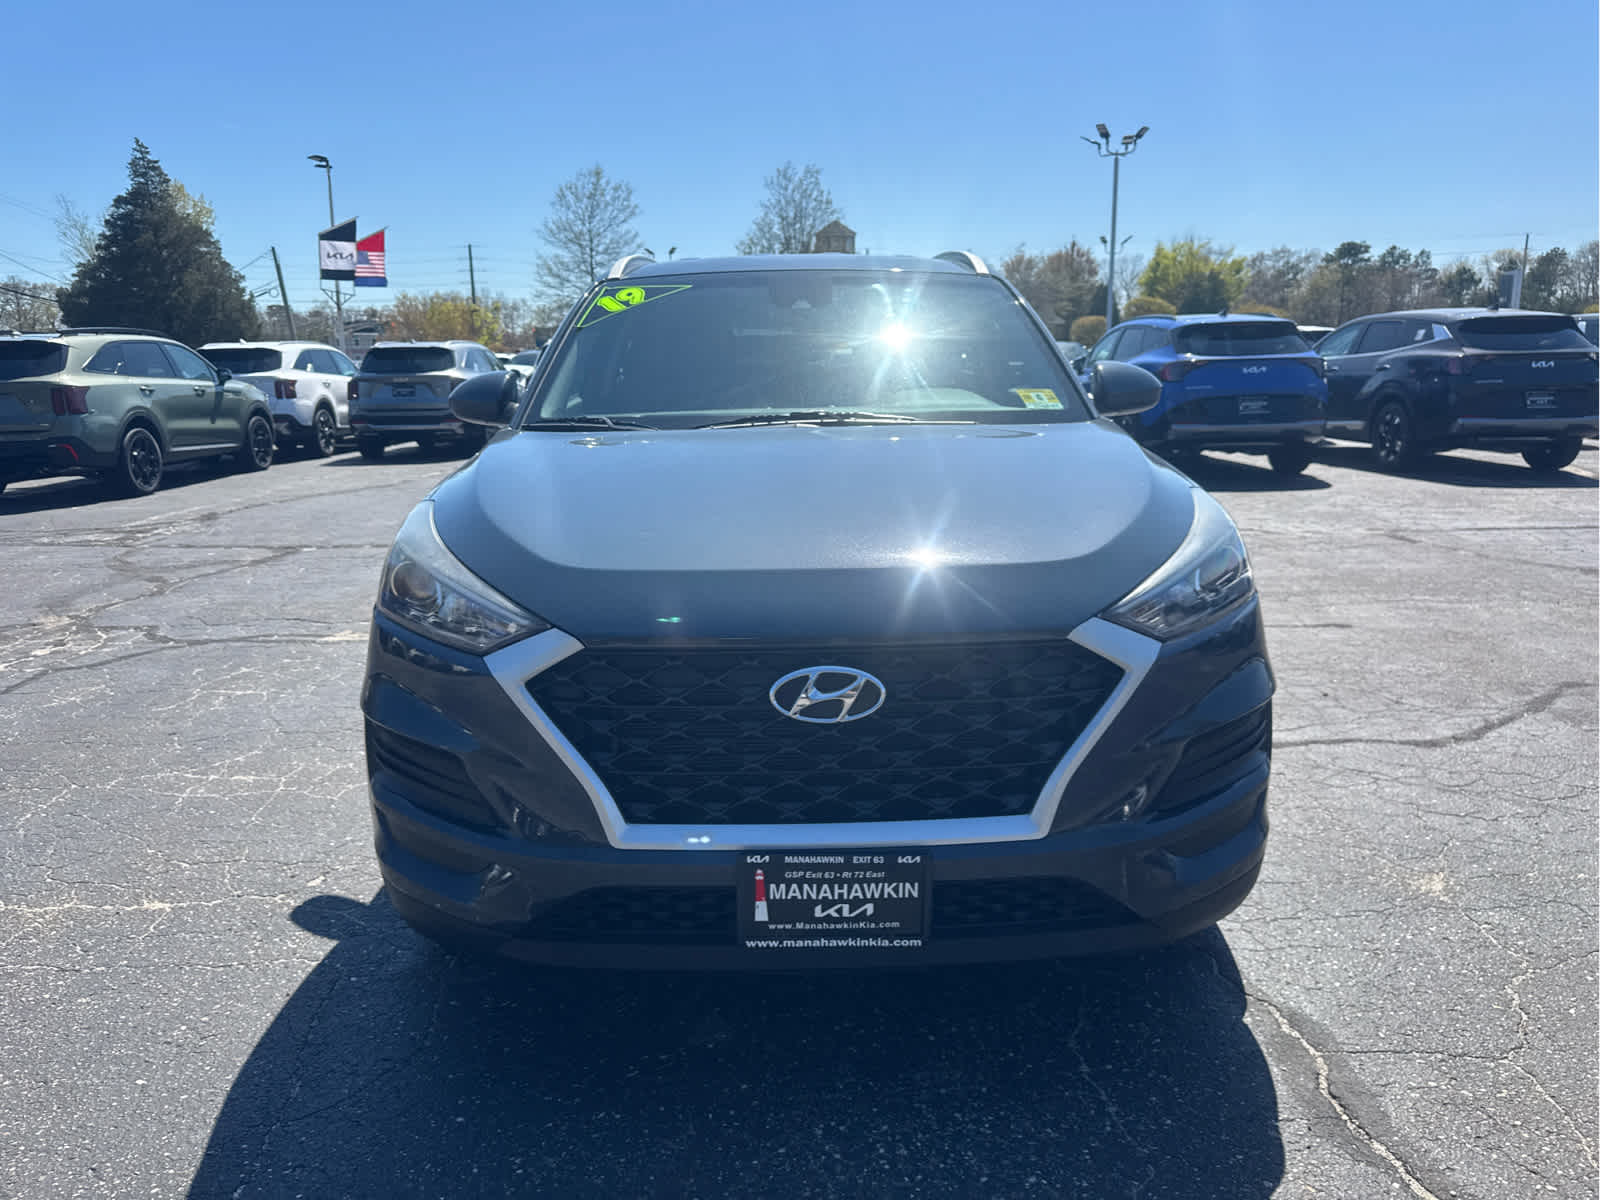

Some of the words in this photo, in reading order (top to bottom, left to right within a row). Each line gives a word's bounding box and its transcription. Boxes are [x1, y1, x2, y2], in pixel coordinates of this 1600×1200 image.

[597, 287, 646, 312] 19
[746, 855, 770, 864] KIA
[784, 855, 844, 864] MANAHAWKIN
[853, 855, 871, 864] EXIT
[873, 855, 884, 864] 63
[897, 855, 921, 864] KIA
[769, 882, 919, 900] MANAHAWKIN
[814, 903, 874, 917] KIA
[768, 921, 900, 929] www.ManahawkinKia.com
[745, 938, 922, 948] www.manahawkinkia.com
